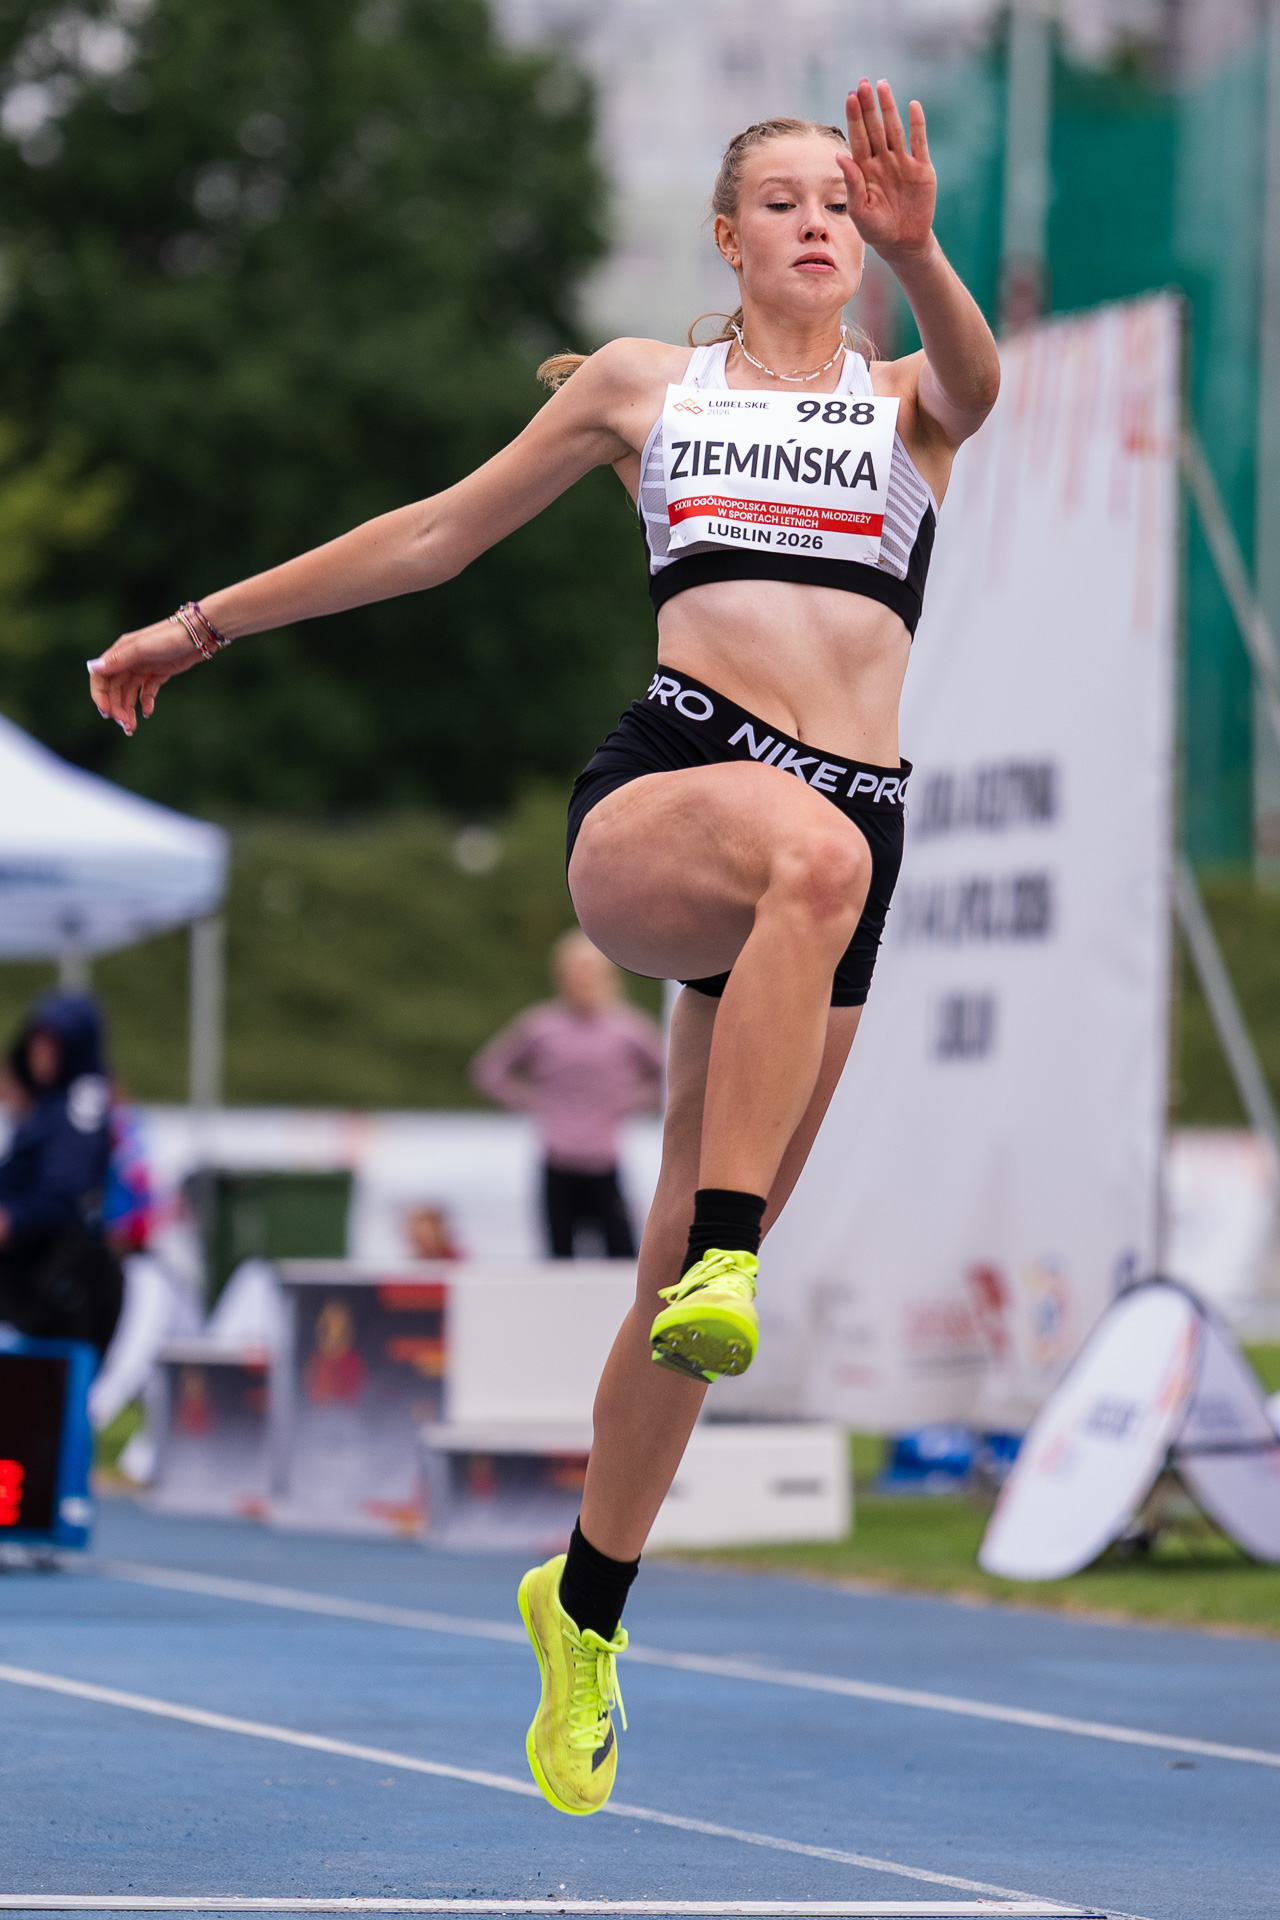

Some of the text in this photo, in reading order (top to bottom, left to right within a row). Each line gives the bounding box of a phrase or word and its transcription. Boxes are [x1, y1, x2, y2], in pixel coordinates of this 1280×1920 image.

[707, 408, 730, 416] 2026
[708, 400, 770, 410] LUBELSKIE
[796, 400, 875, 425] 988
[670, 438, 878, 491] ZIEMIŃSKA
[674, 496, 872, 524] XXXII OGÓLNOPOLSKA OLIMPIADA MŁODZIEŻY
[717, 507, 819, 528] W SPORTACH LETNICH
[707, 522, 824, 550] LUBLIN 2026
[727, 722, 848, 793] NIKE
